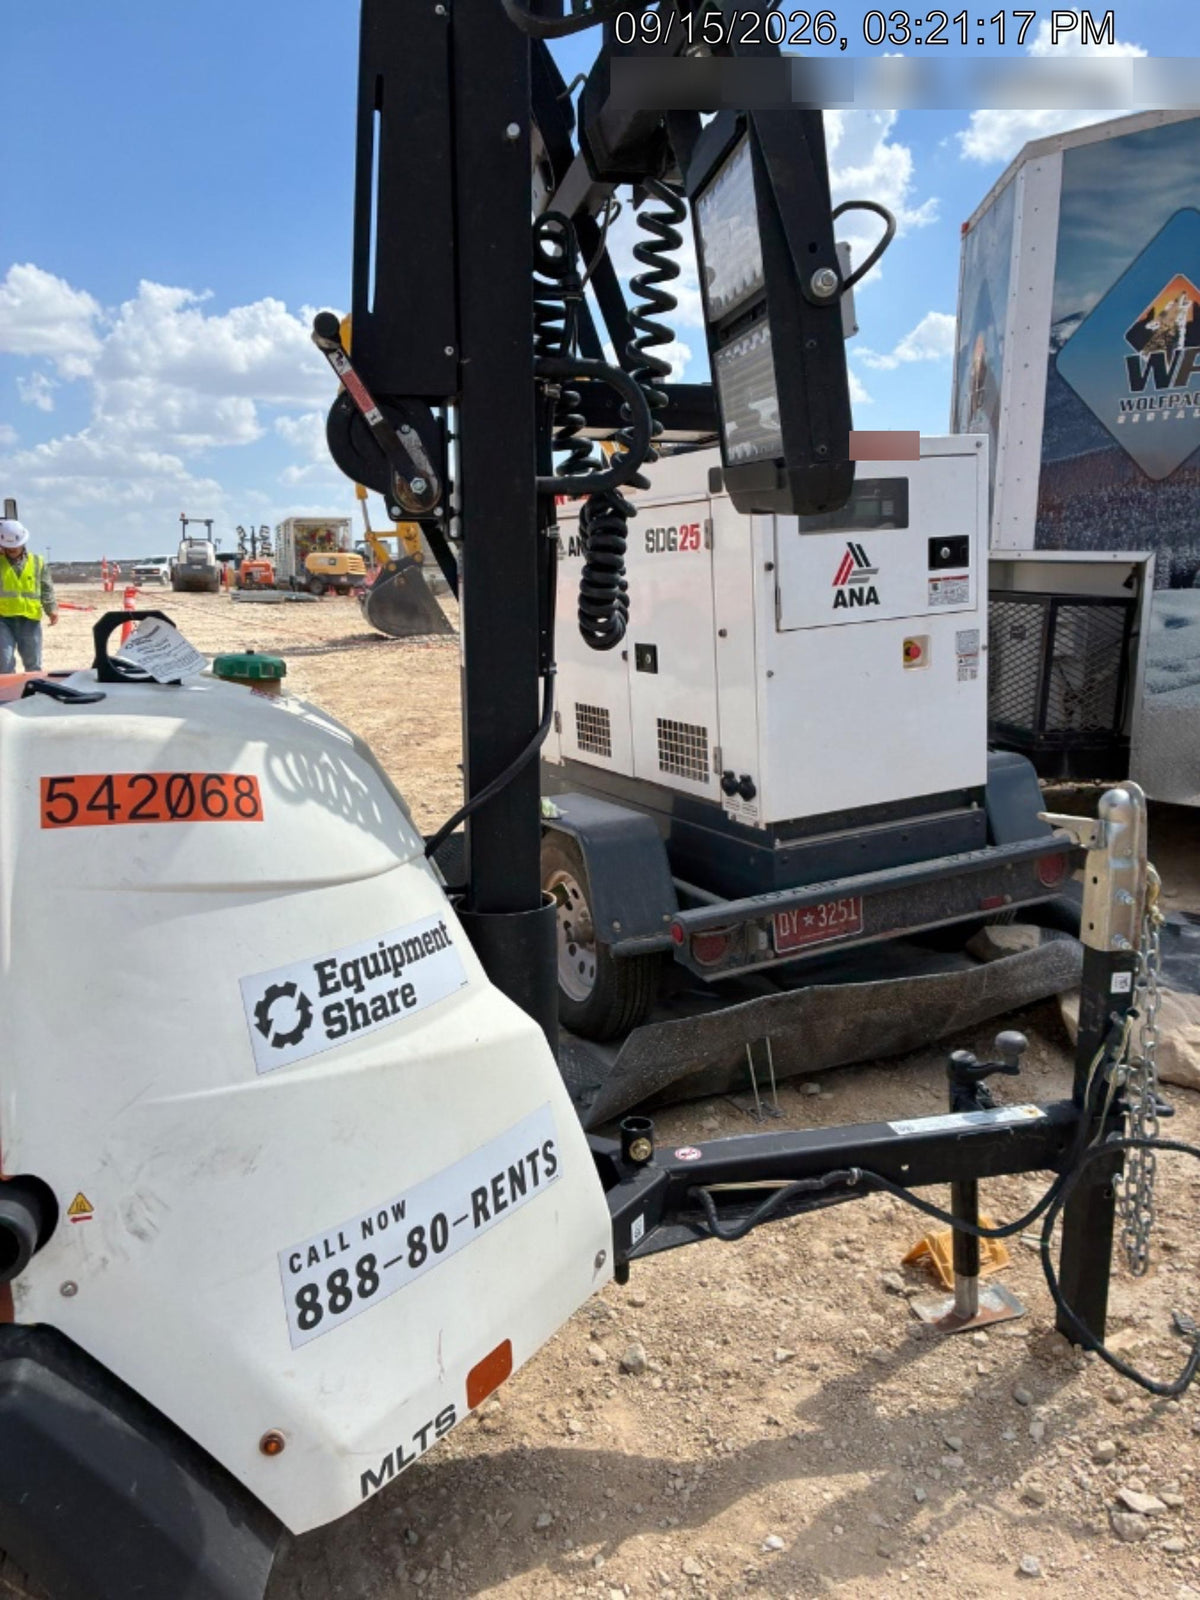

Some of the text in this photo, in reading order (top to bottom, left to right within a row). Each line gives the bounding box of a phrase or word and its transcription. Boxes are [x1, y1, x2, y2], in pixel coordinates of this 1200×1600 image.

[645, 523, 701, 553] SDG25
[832, 585, 880, 609] ANA
[45, 773, 258, 824] 542068
[817, 897, 858, 928] 3251
[313, 920, 453, 998] Equipment
[322, 981, 417, 1040] Share
[289, 1199, 406, 1274] CALL NOW
[295, 1139, 558, 1331] 888-80-RENTS
[360, 1403, 456, 1499] MLTS
